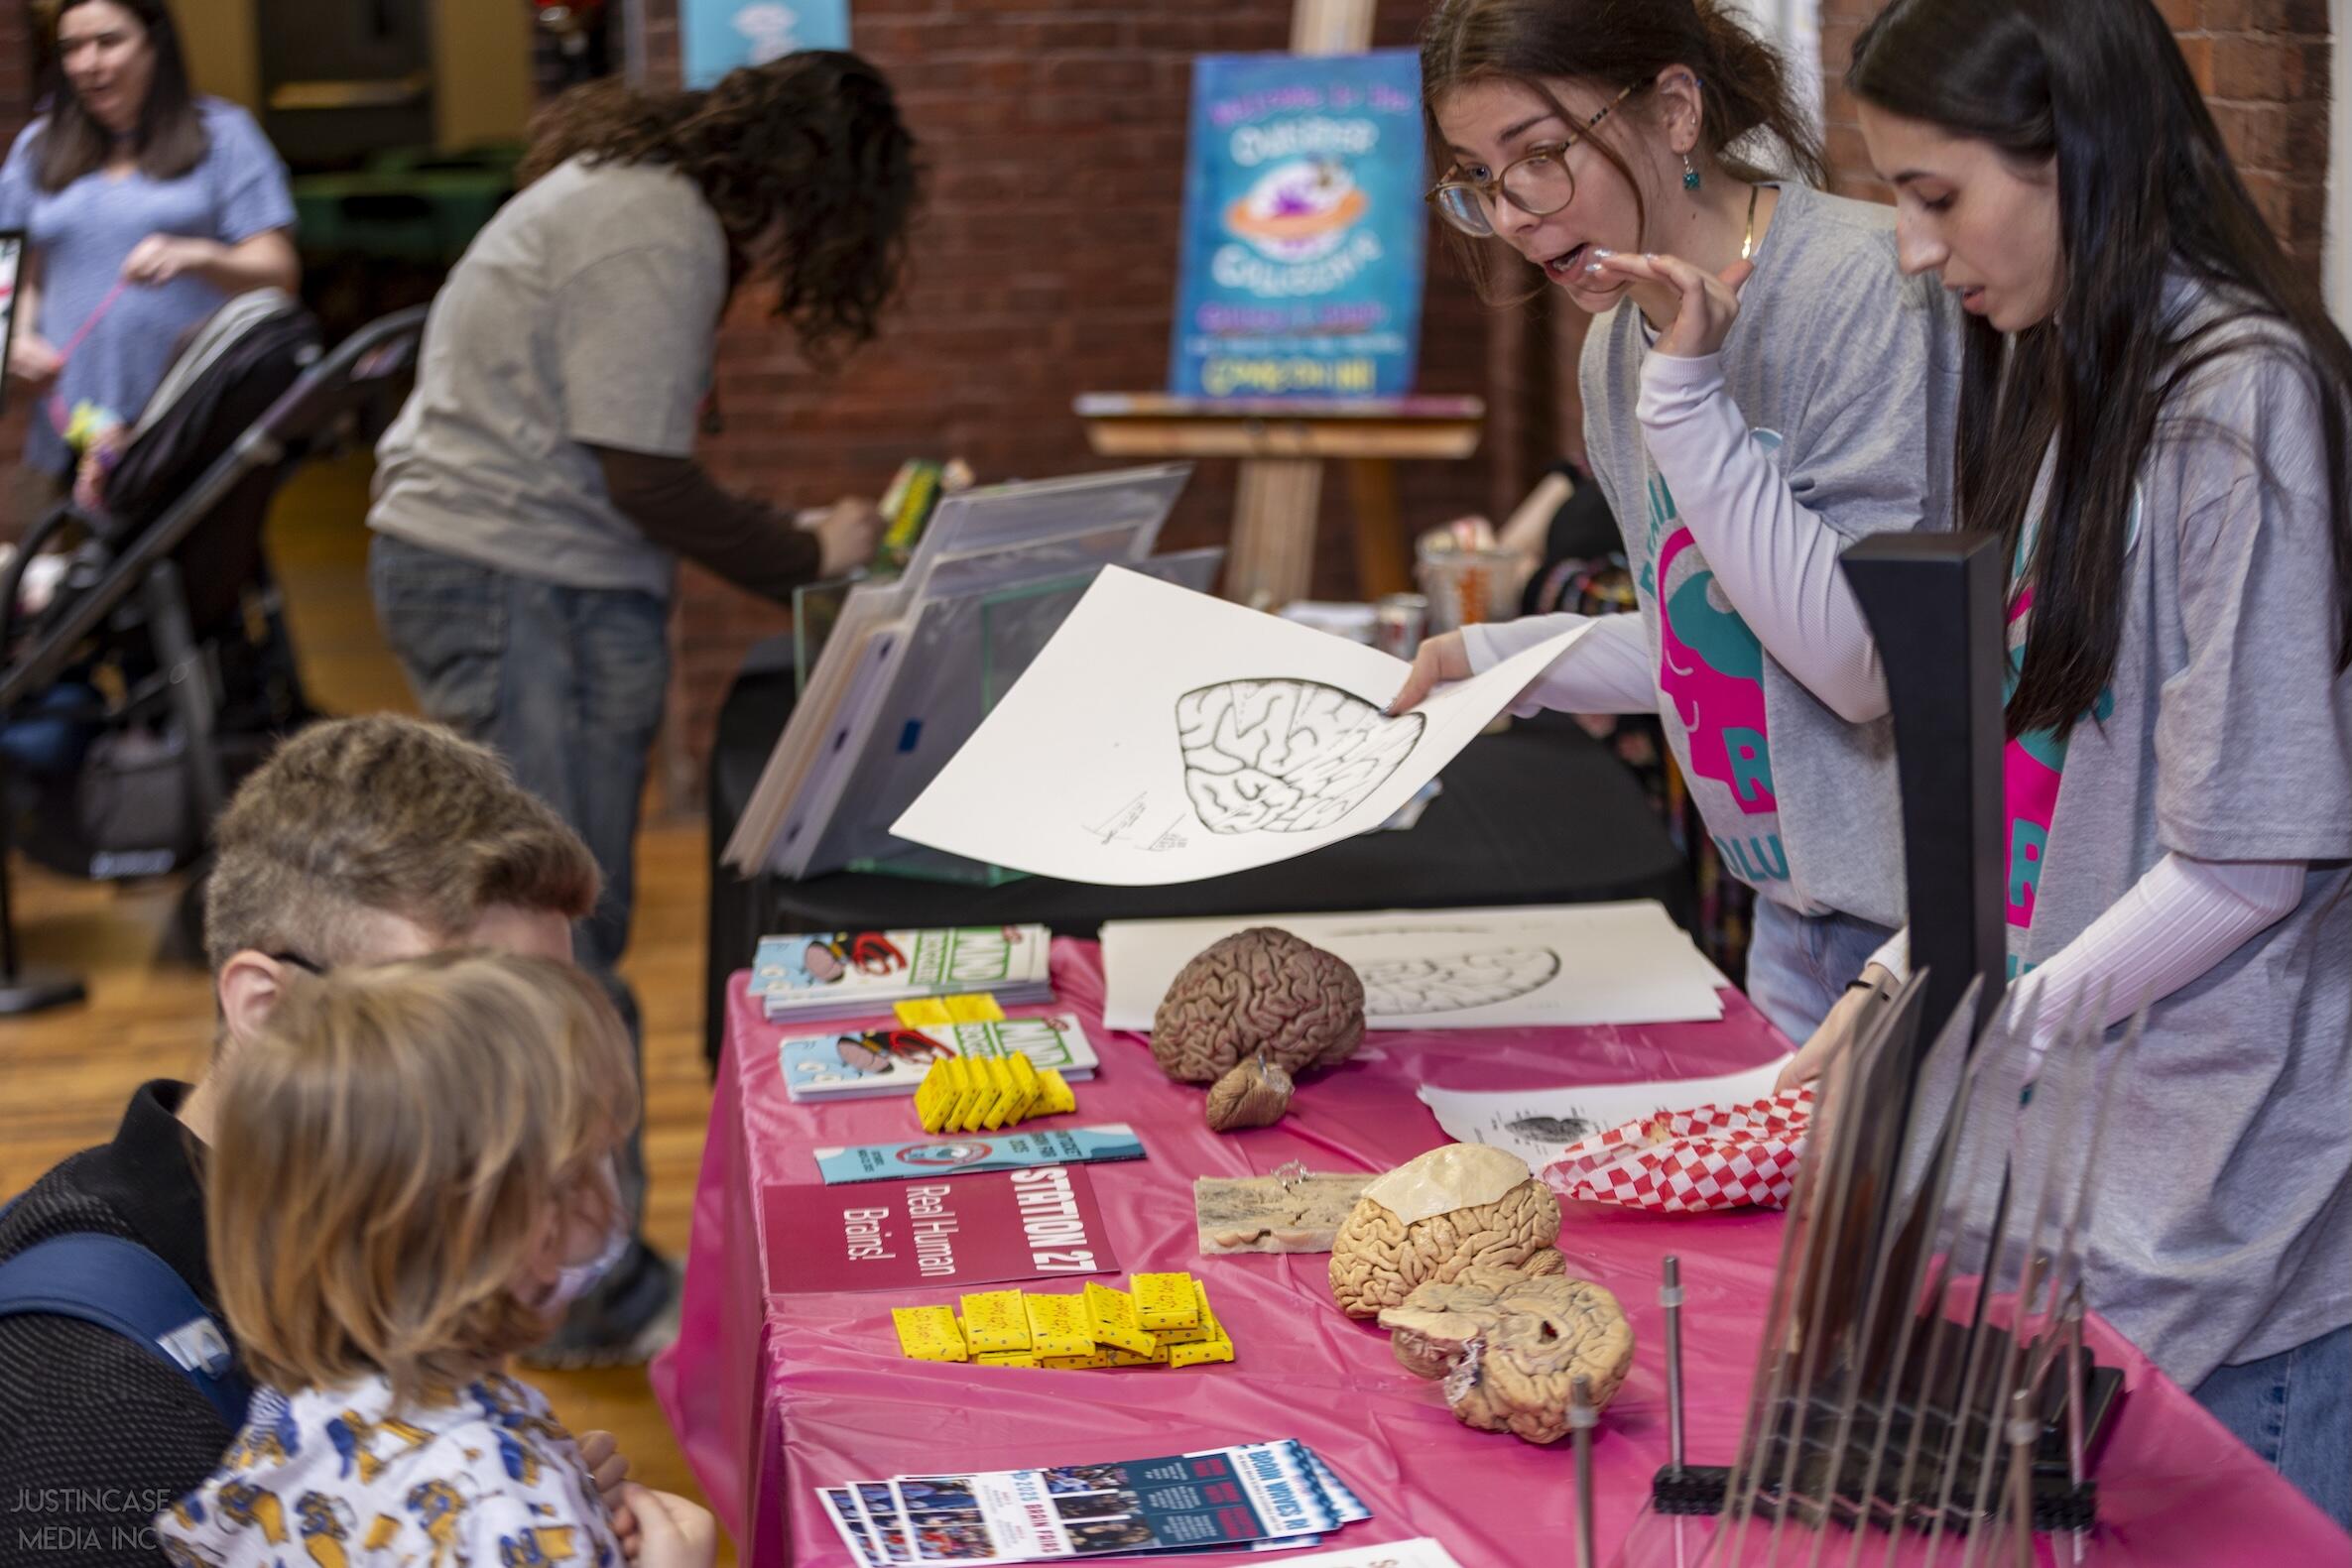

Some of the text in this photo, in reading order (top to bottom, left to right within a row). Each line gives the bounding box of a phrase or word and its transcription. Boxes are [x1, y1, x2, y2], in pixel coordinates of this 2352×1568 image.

[1722, 727, 1775, 801] R
[906, 1183, 956, 1219] Real
[843, 1207, 897, 1261] Brains!
[1010, 1167, 1097, 1270] STATION 27
[912, 1219, 959, 1276] Human
[1247, 1450, 1285, 1482] BRAIN
[1016, 1479, 1039, 1502] 2025
[1265, 1482, 1303, 1516] WAVES
[1024, 1504, 1050, 1528] BRAIN
[1285, 1517, 1310, 1530] RI
[1034, 1529, 1060, 1554] FAIRS
